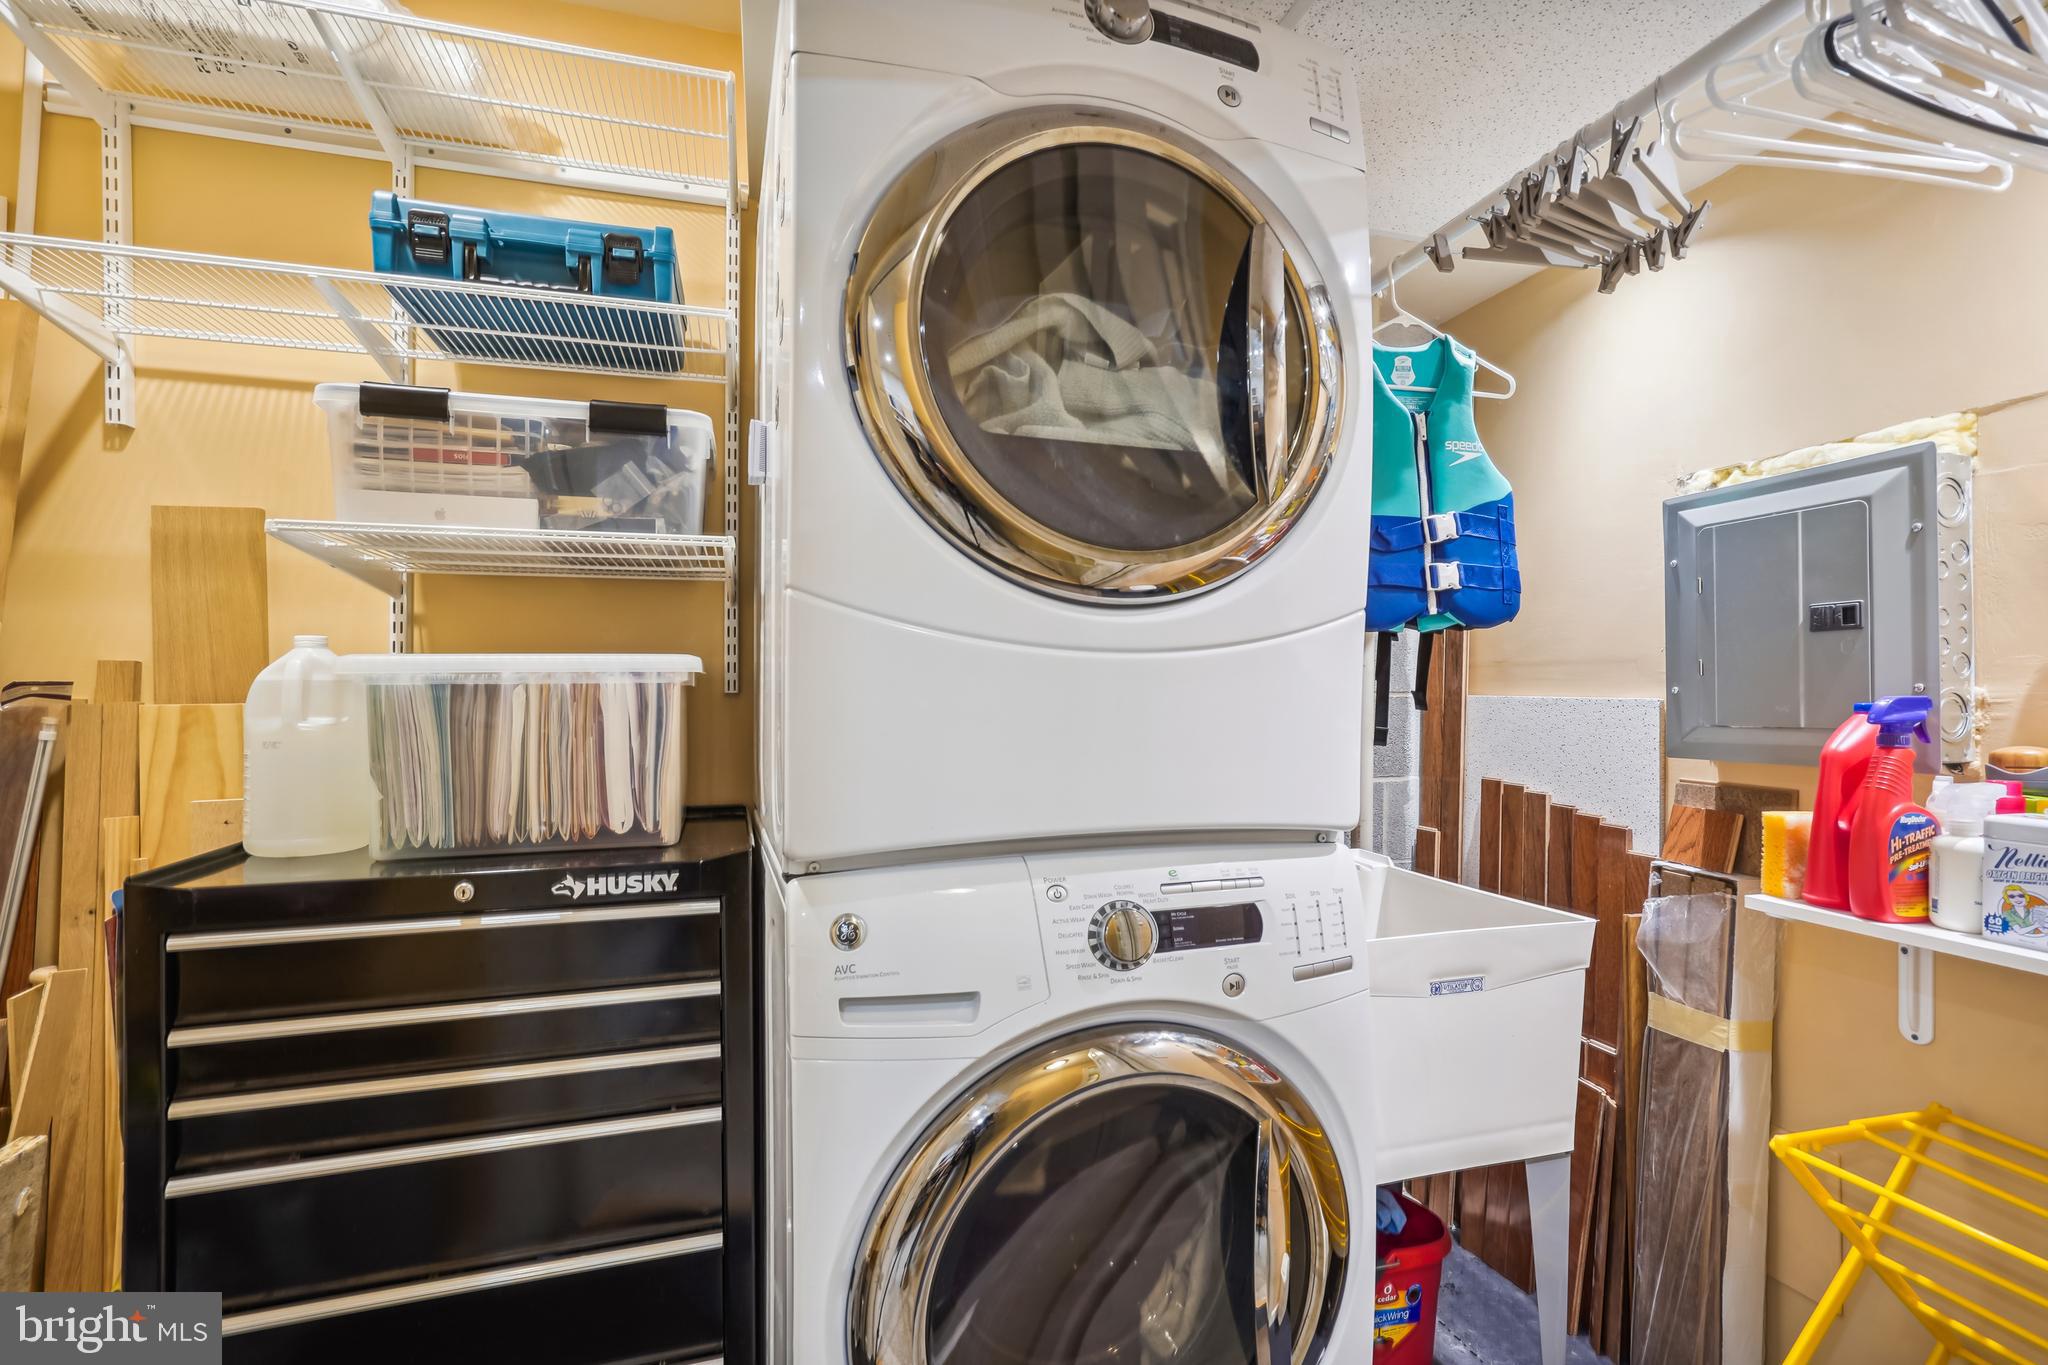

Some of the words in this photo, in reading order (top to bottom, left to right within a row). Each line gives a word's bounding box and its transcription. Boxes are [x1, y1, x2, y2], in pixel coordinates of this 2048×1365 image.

[586, 872, 680, 896] HUSKY
[834, 963, 857, 976] AVC
[1375, 1310, 1409, 1322] ickWring
